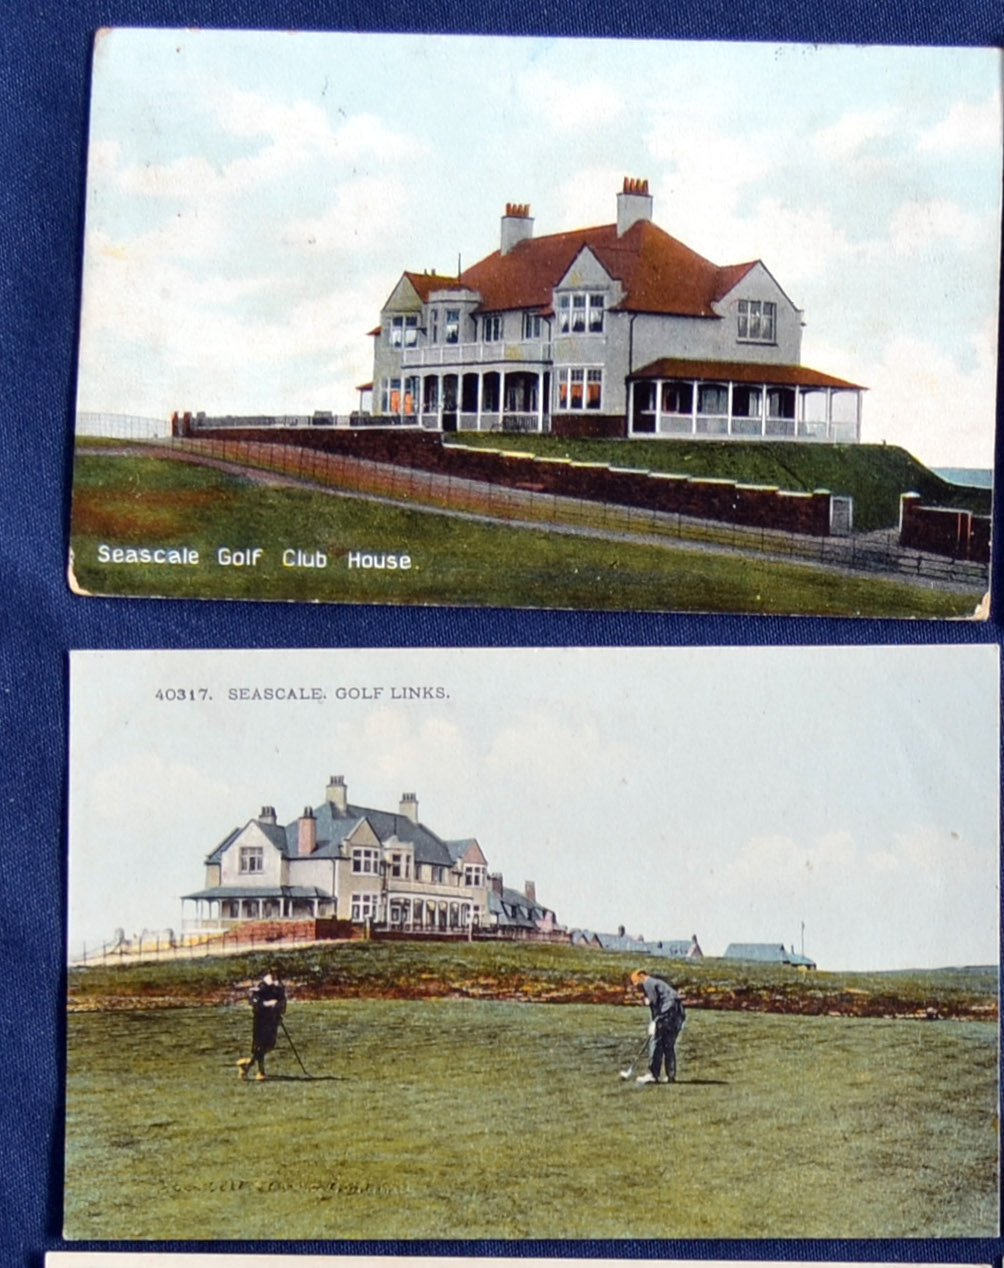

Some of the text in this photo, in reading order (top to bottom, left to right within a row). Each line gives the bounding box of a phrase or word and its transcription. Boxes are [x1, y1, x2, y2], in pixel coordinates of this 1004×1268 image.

[98, 545, 199, 565] Seascale
[218, 548, 263, 566] Golf
[282, 549, 327, 568] Club
[155, 688, 213, 701] 40317.
[335, 687, 384, 700] GOLF
[391, 687, 450, 700] LINKS.
